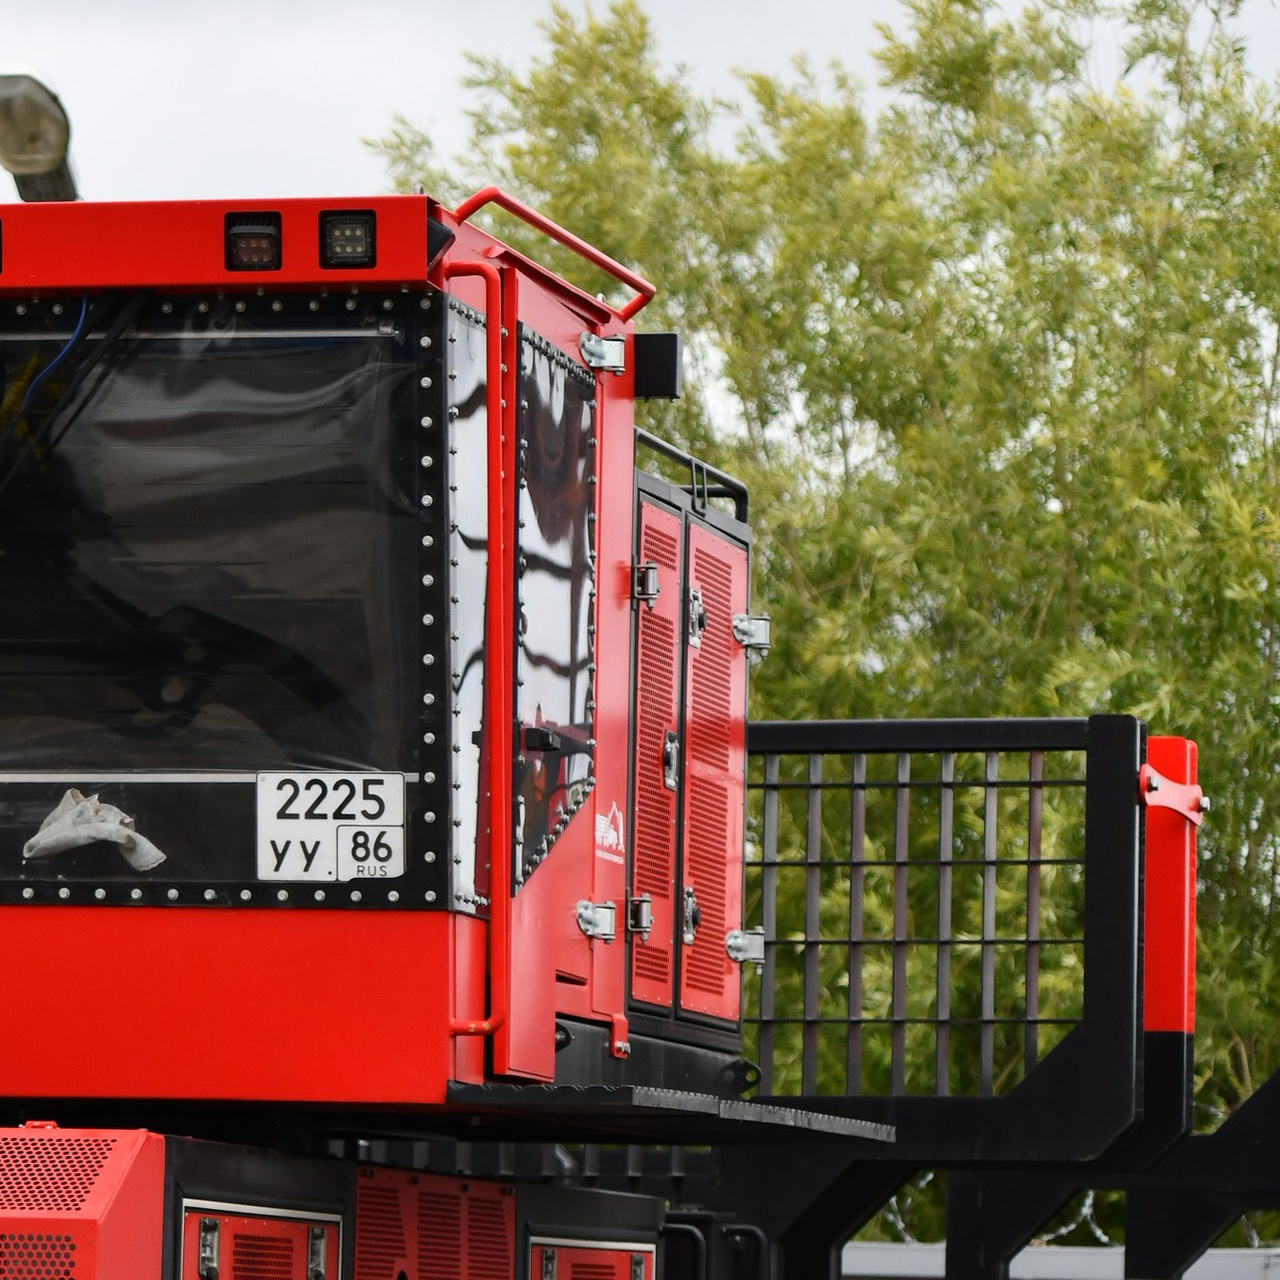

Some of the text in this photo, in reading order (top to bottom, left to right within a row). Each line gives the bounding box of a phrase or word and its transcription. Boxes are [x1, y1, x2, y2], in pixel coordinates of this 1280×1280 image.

[276, 778, 385, 820] 2225
[351, 830, 392, 862] 86
[356, 865, 387, 877] RUS
